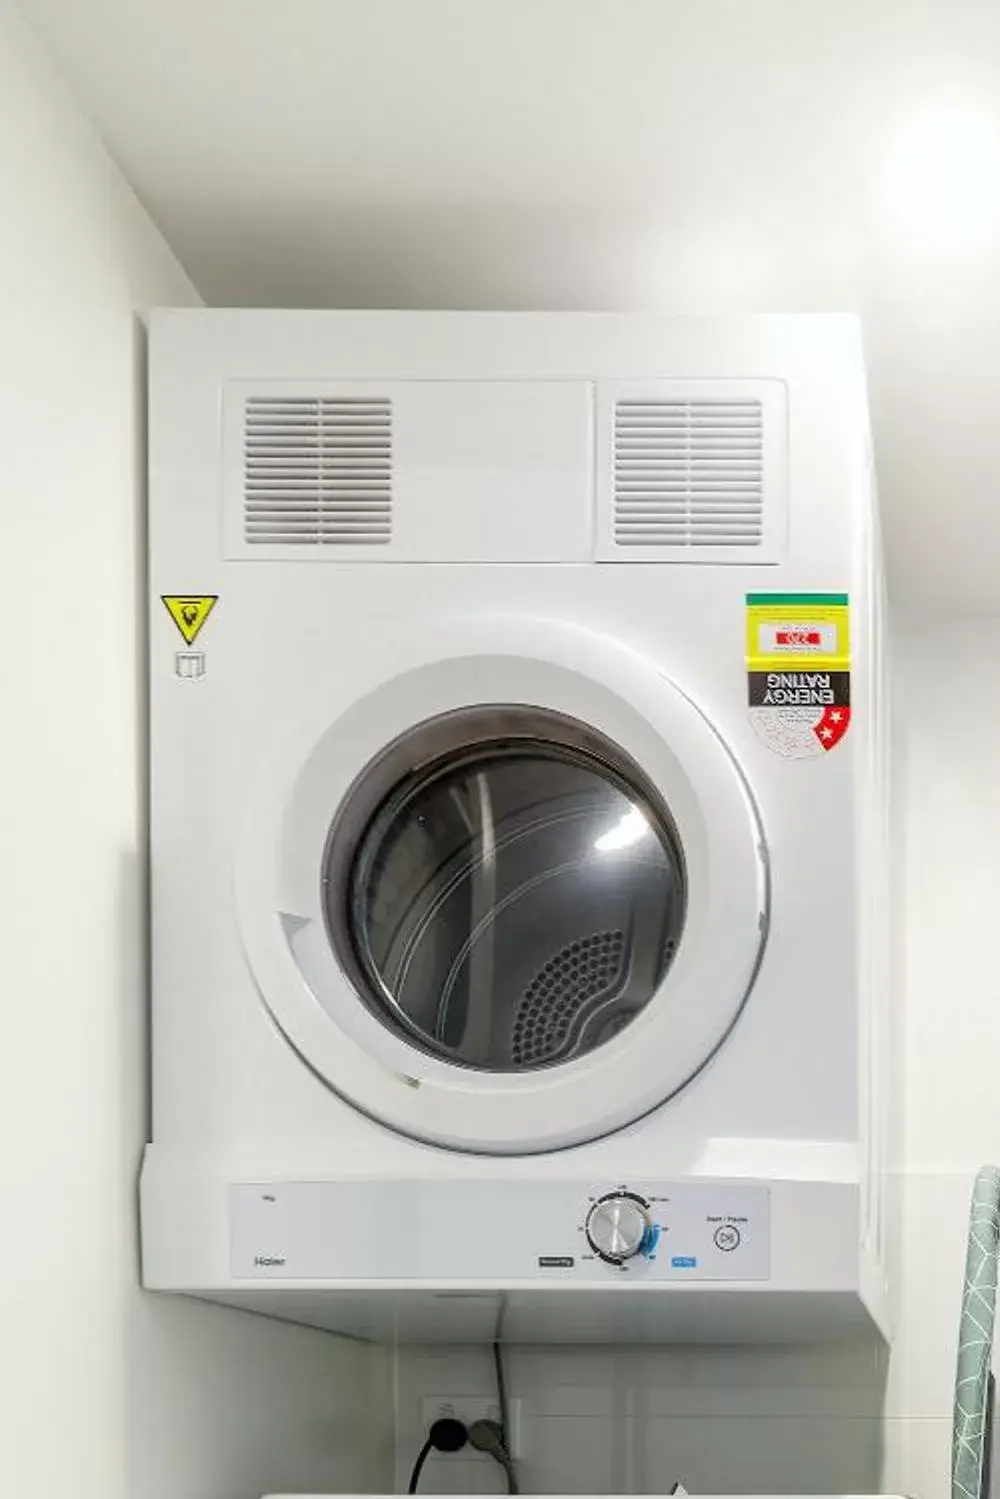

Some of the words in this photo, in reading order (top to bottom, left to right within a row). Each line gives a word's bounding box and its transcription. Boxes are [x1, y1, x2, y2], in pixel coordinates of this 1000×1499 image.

[767, 673, 830, 688] RATING
[762, 689, 834, 704] ENERGY
[254, 1256, 285, 1266] Haier
